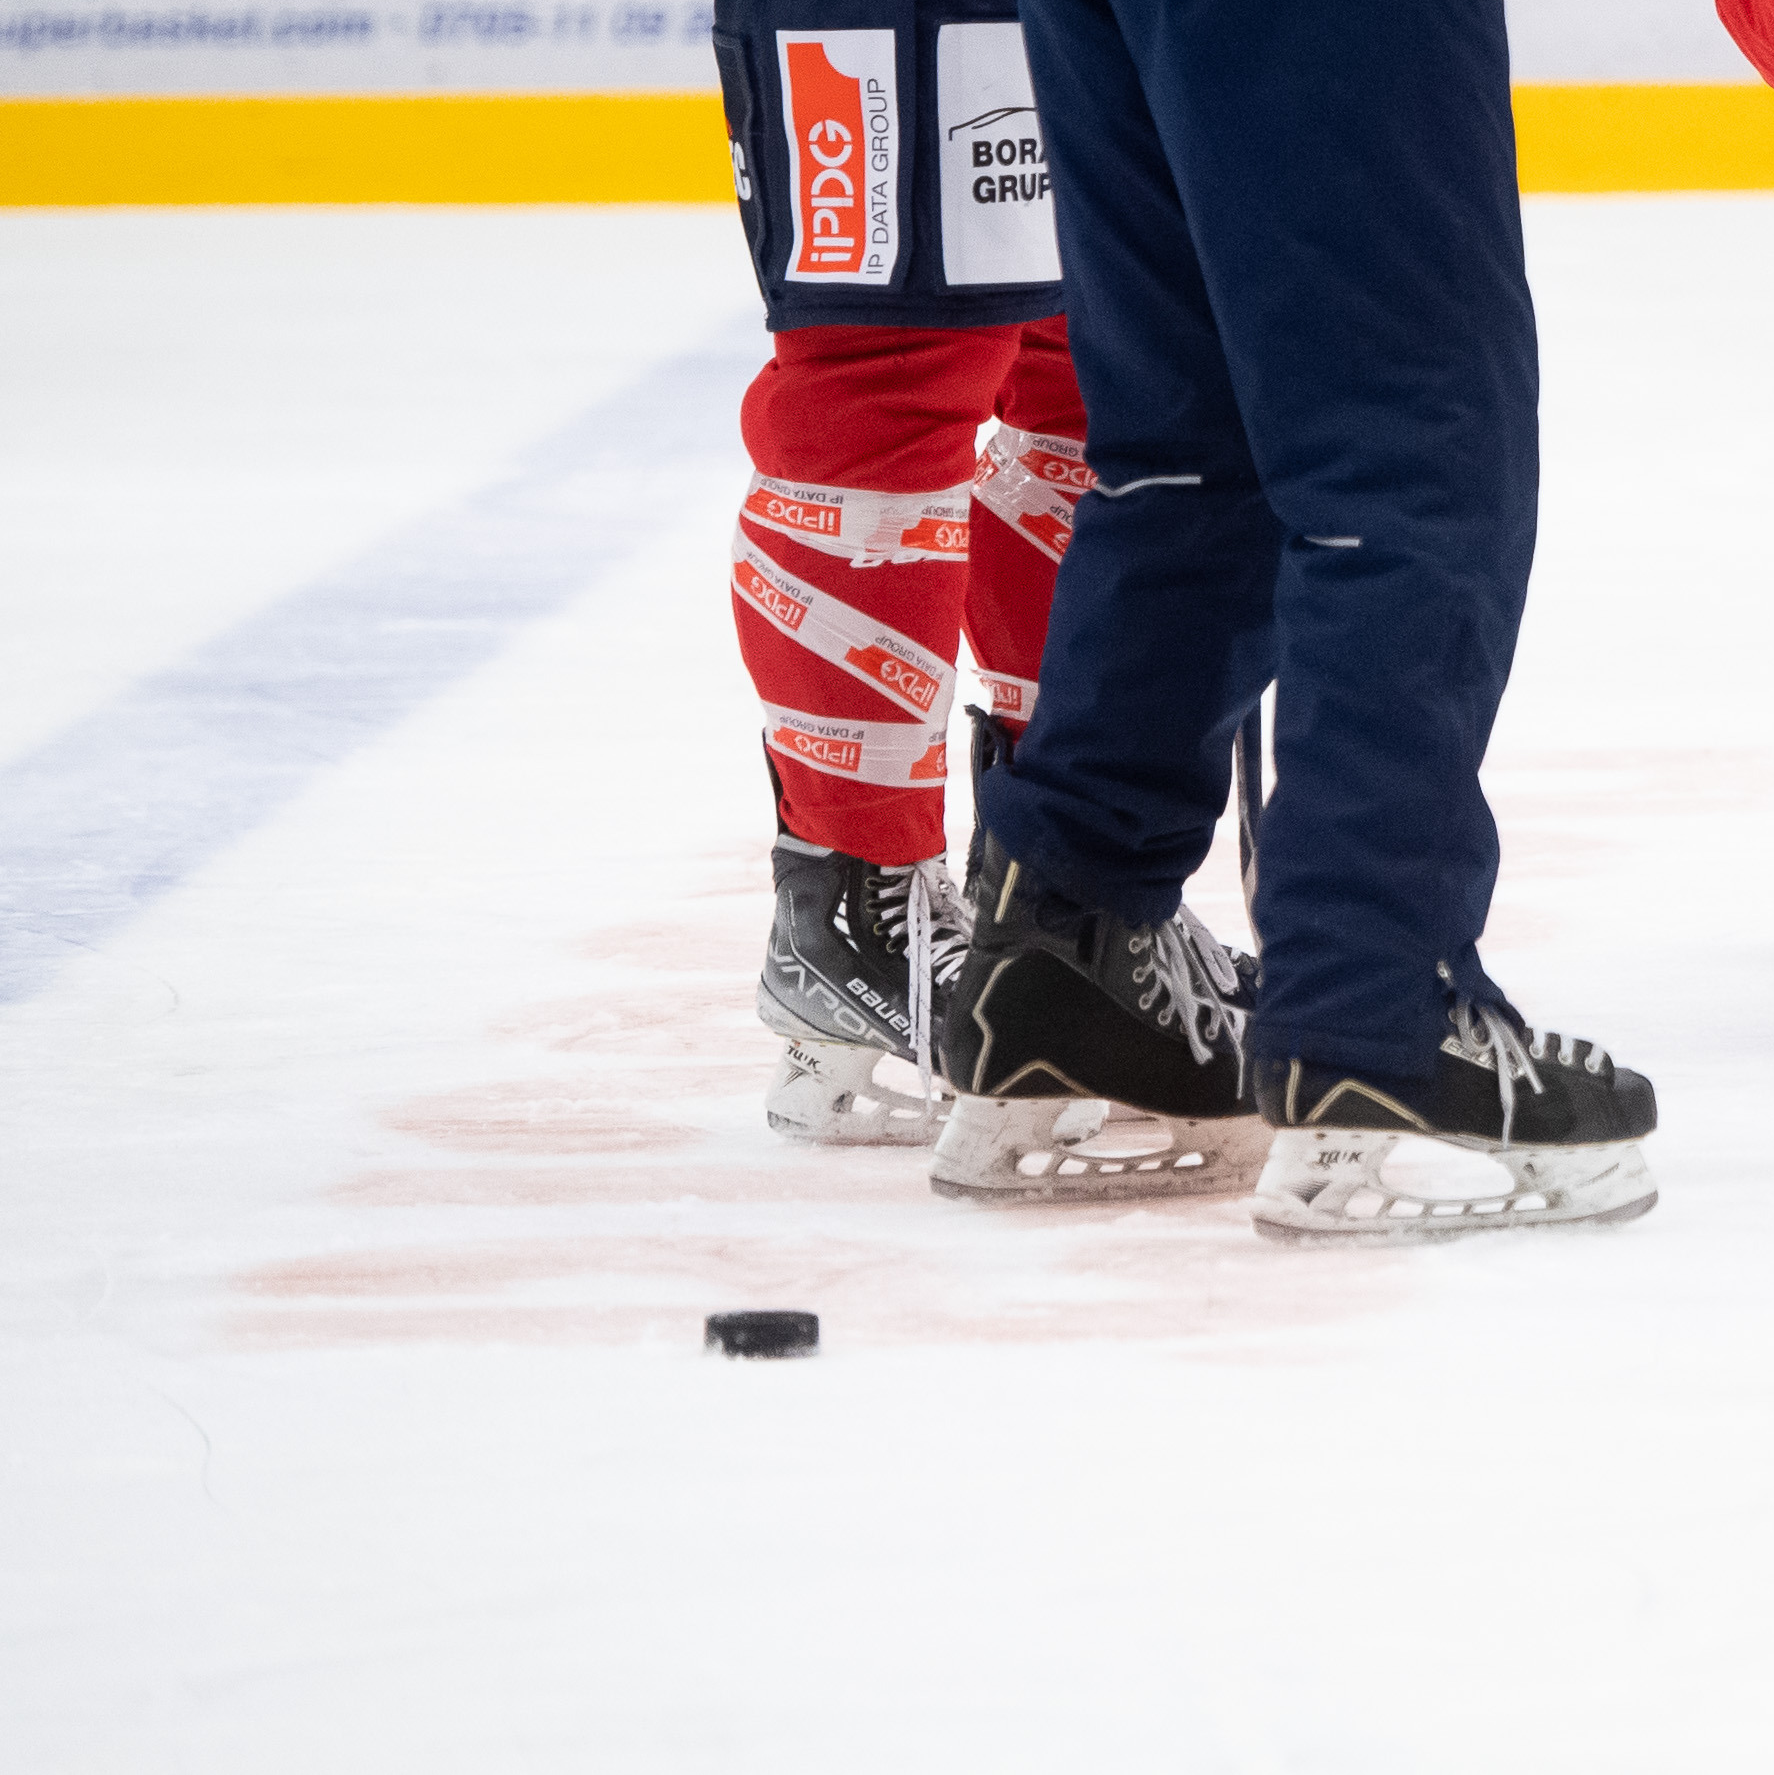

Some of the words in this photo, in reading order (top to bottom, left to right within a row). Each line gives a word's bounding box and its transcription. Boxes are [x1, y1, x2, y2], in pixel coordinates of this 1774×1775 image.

[866, 77, 890, 173] GROUP
[971, 137, 1046, 169] BOR
[870, 180, 889, 245] DATA
[866, 253, 884, 276] IP
[875, 635, 916, 662] GROUP
[818, 726, 849, 738] DATA
